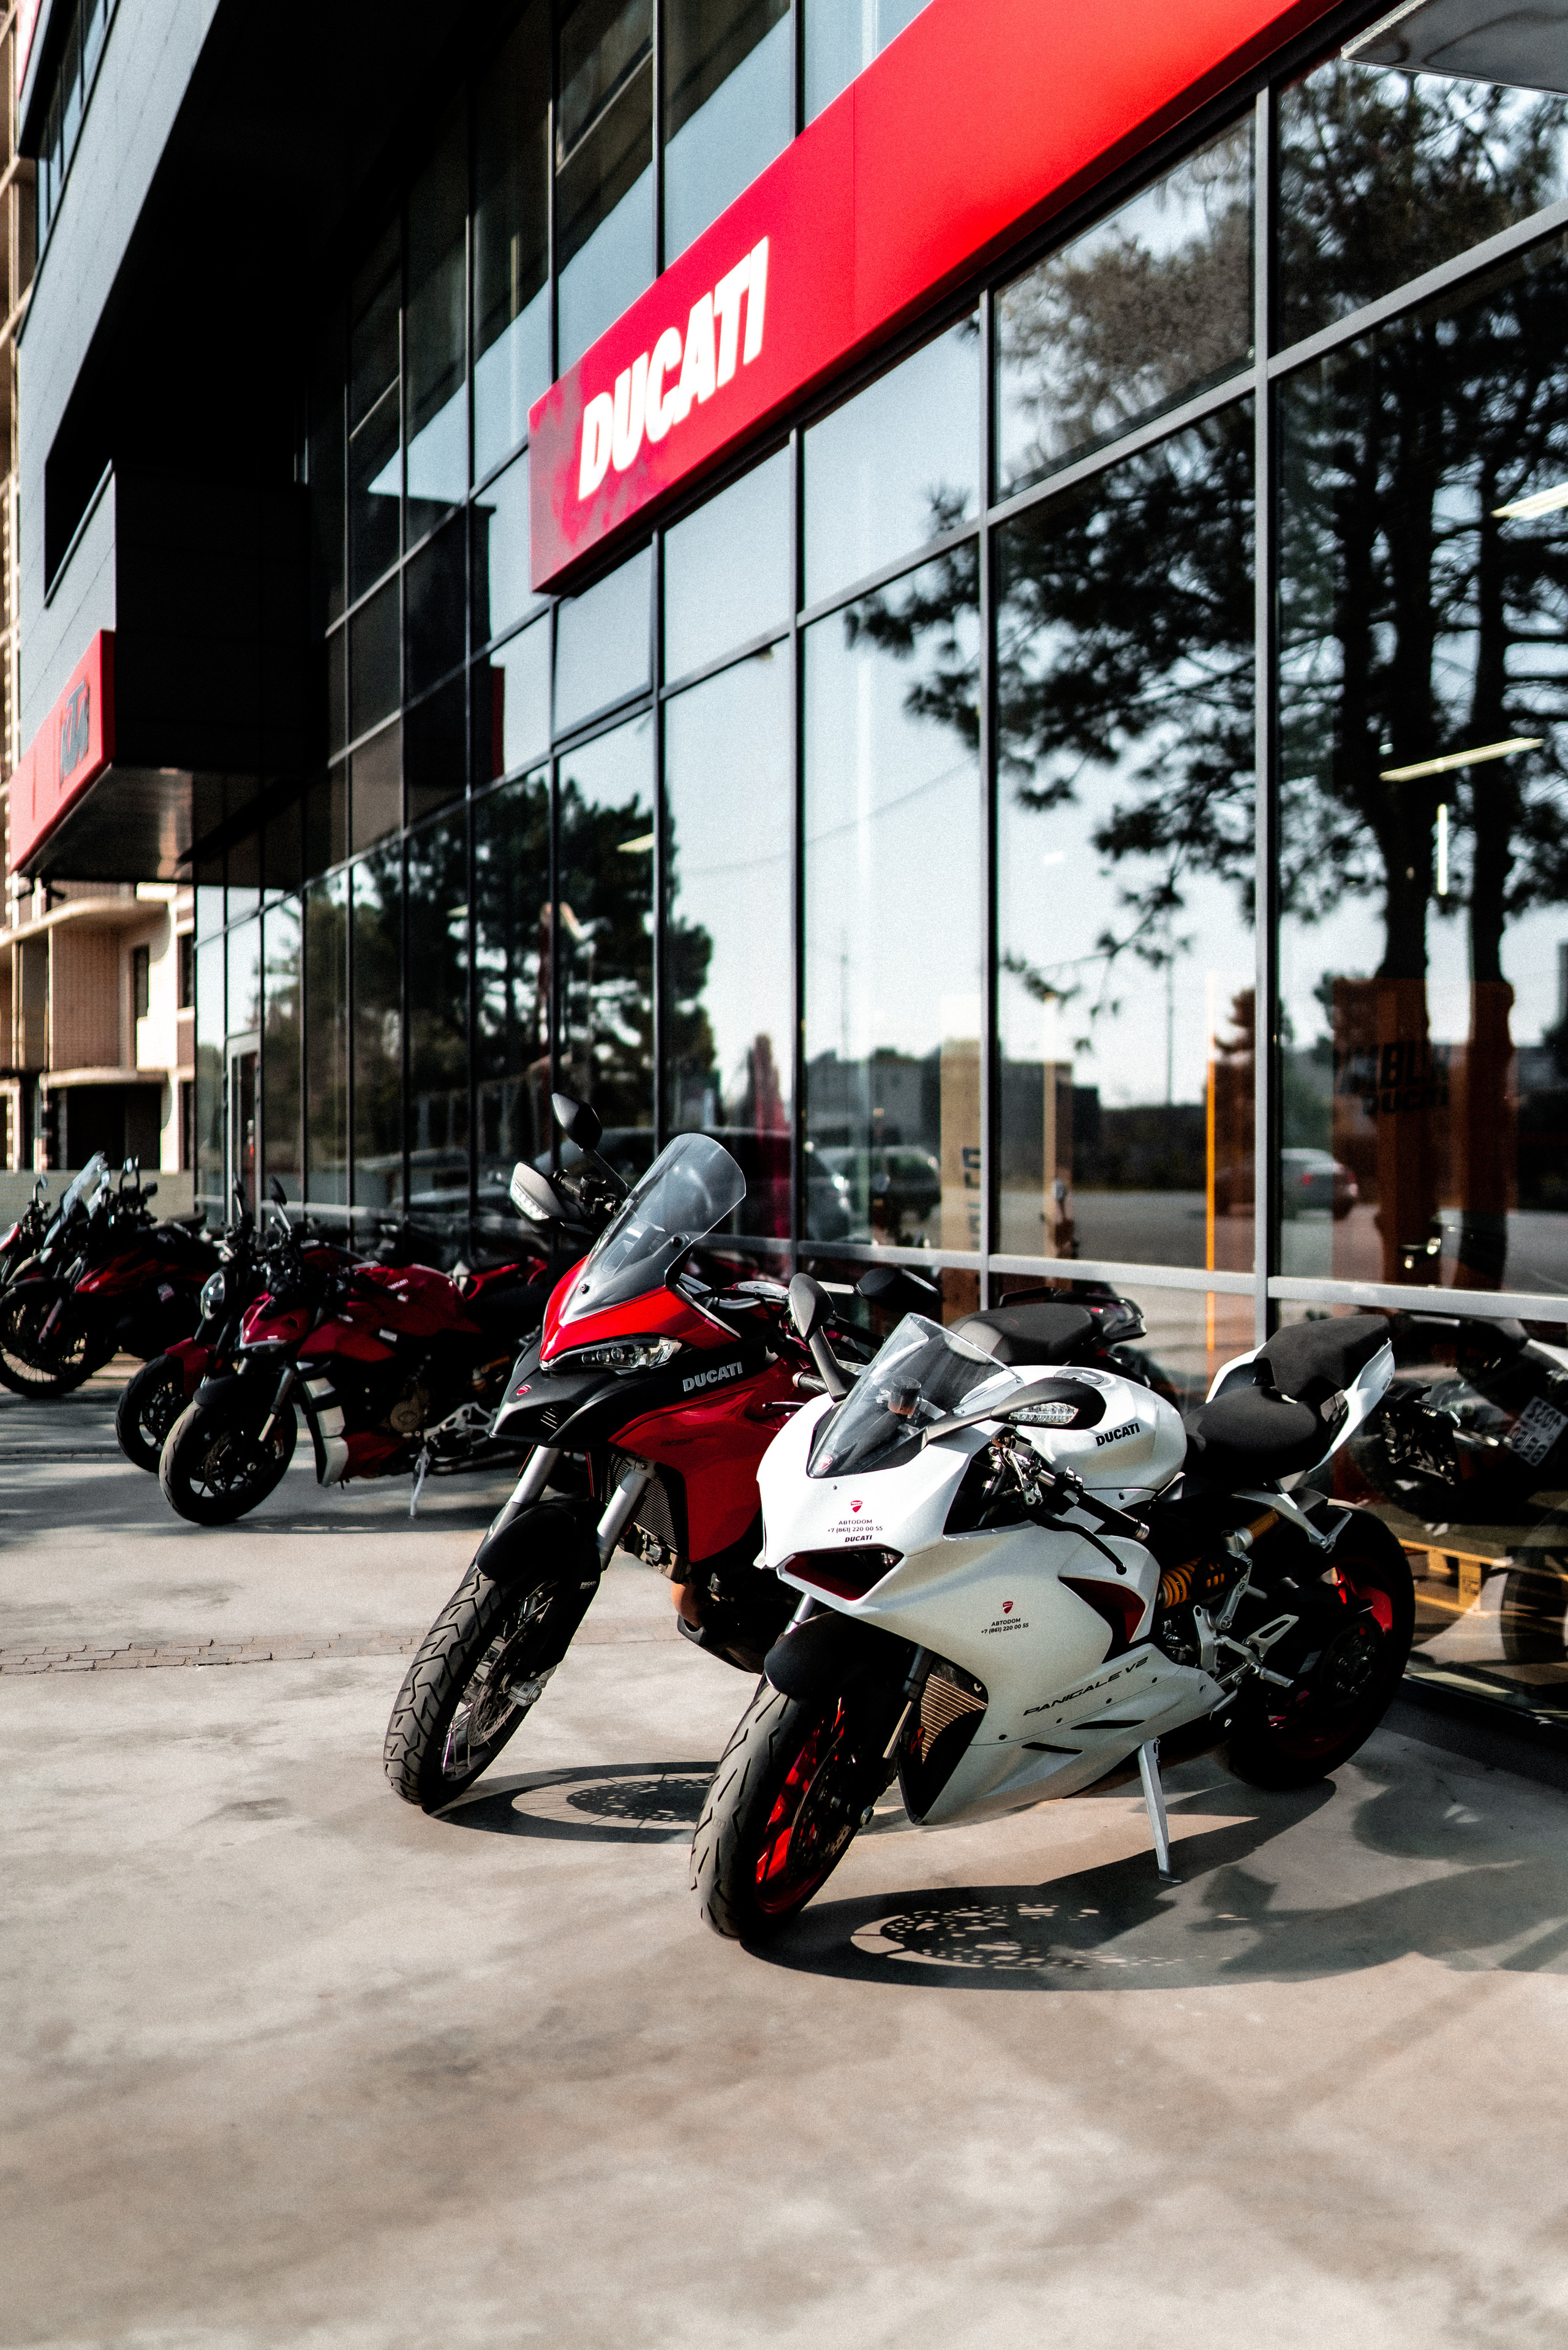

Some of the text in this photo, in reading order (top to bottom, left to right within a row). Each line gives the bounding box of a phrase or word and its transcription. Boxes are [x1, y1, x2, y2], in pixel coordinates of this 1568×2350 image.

[578, 236, 769, 502] DUCATI
[683, 1361, 743, 1392] DUCATI
[1095, 1423, 1140, 1447] DUCATI
[1023, 1656, 1148, 1715] PANIGALE V2
